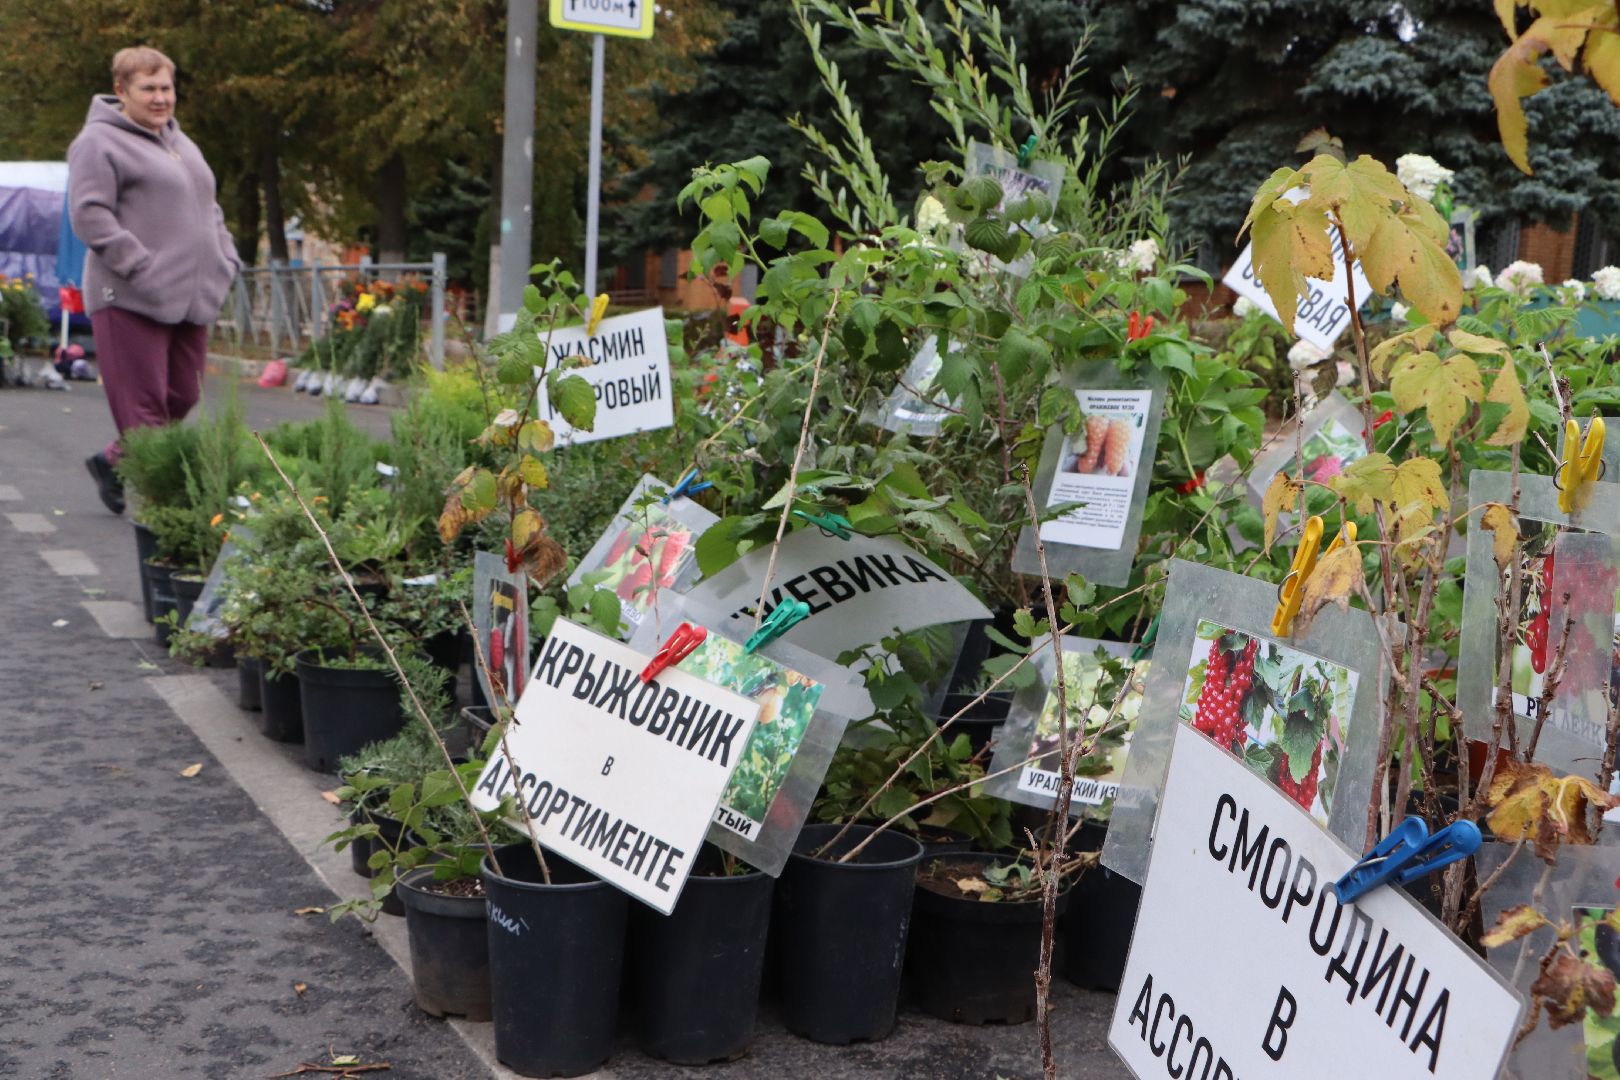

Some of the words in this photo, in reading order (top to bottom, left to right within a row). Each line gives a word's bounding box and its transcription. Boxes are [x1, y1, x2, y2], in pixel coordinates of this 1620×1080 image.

[551, 327, 645, 368] ЖАСМИН
[730, 553, 948, 622] ЕВИКА
[535, 636, 745, 768] КРЫЖОВНИК
[717, 806, 753, 836] ТЫЙ
[1028, 771, 1099, 799] УРАЛКИЙ
[477, 757, 684, 892] АССОРТИМЕНТЕ
[1208, 793, 1451, 1075] СМОРОДИНА
[1261, 984, 1297, 1062] В
